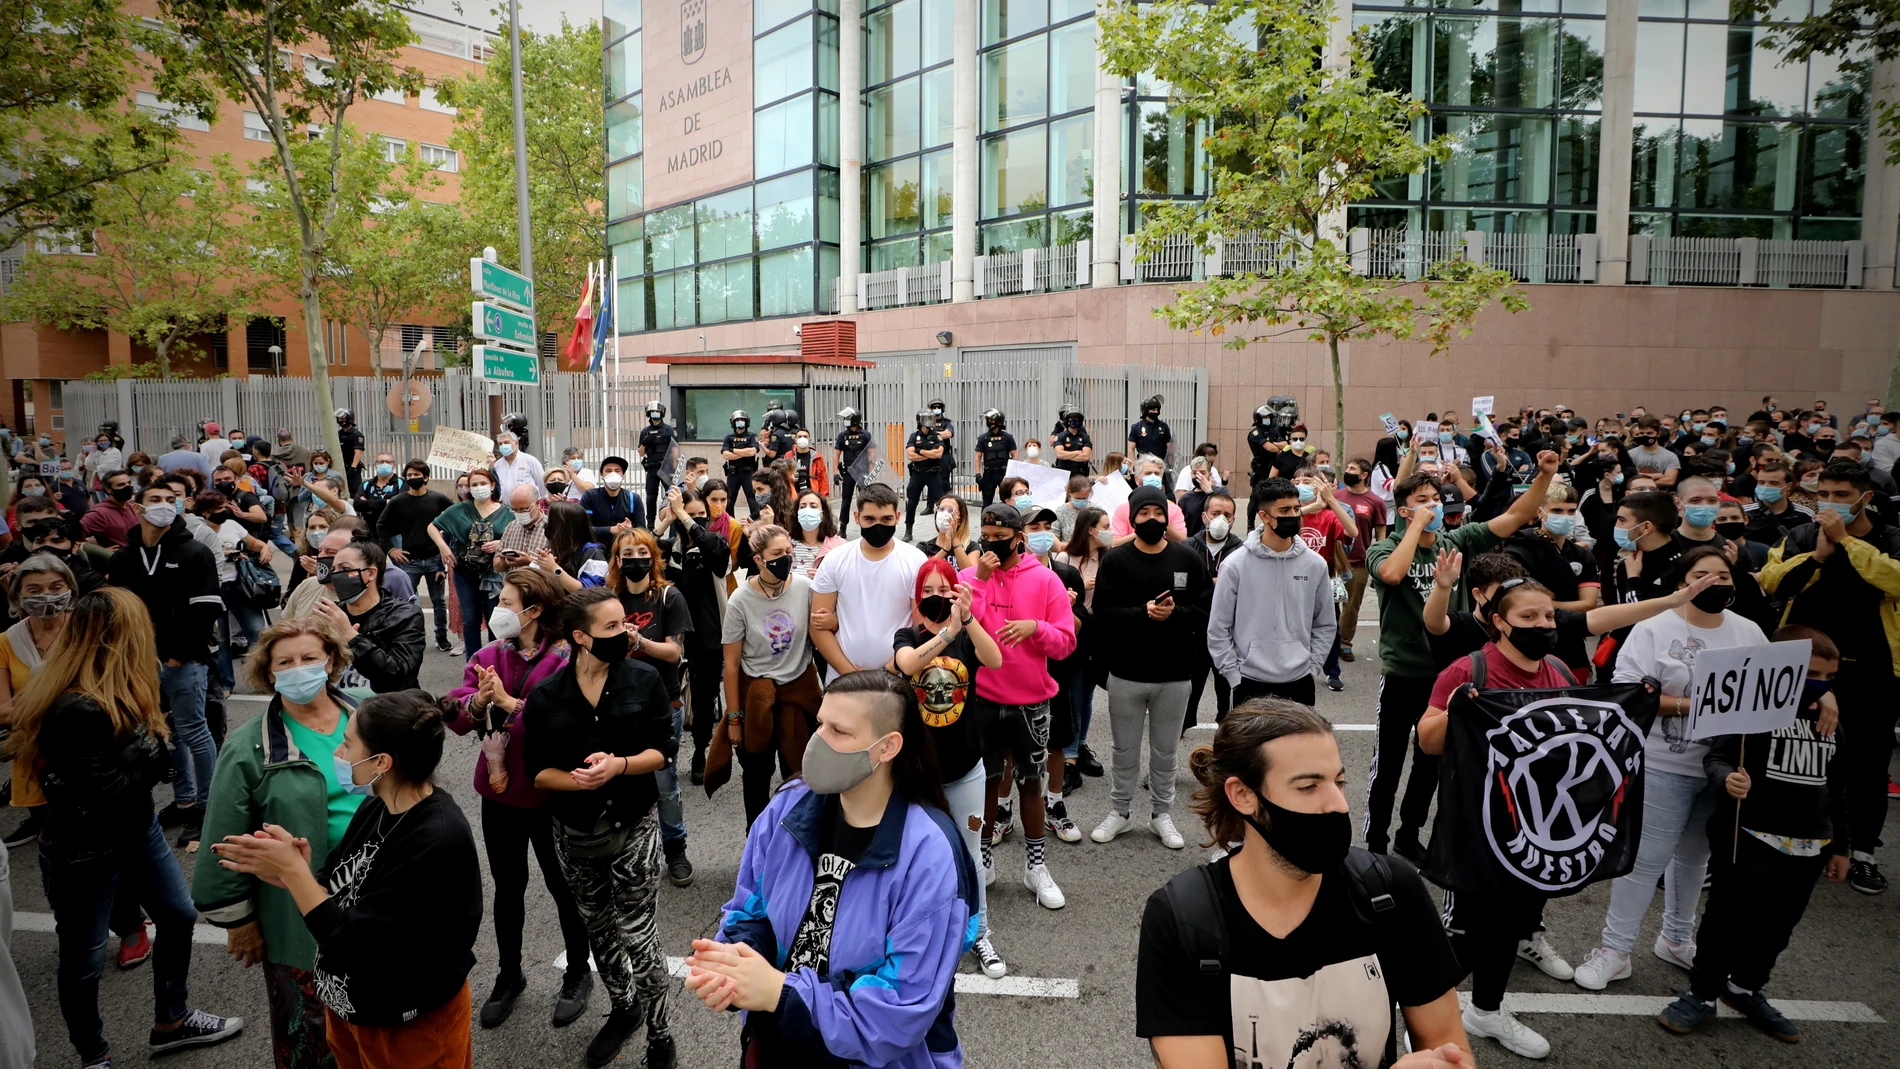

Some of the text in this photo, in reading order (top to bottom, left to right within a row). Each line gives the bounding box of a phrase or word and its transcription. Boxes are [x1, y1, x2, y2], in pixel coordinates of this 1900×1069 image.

[659, 66, 733, 113] ASAMBLEA
[684, 112, 701, 136] DE
[667, 139, 723, 174] MADRID
[485, 365, 515, 378] La Albufera
[435, 435, 453, 445] ESTAR
[452, 431, 475, 442] NIEGO
[1692, 657, 1804, 730] ¡ASÍ NO!
